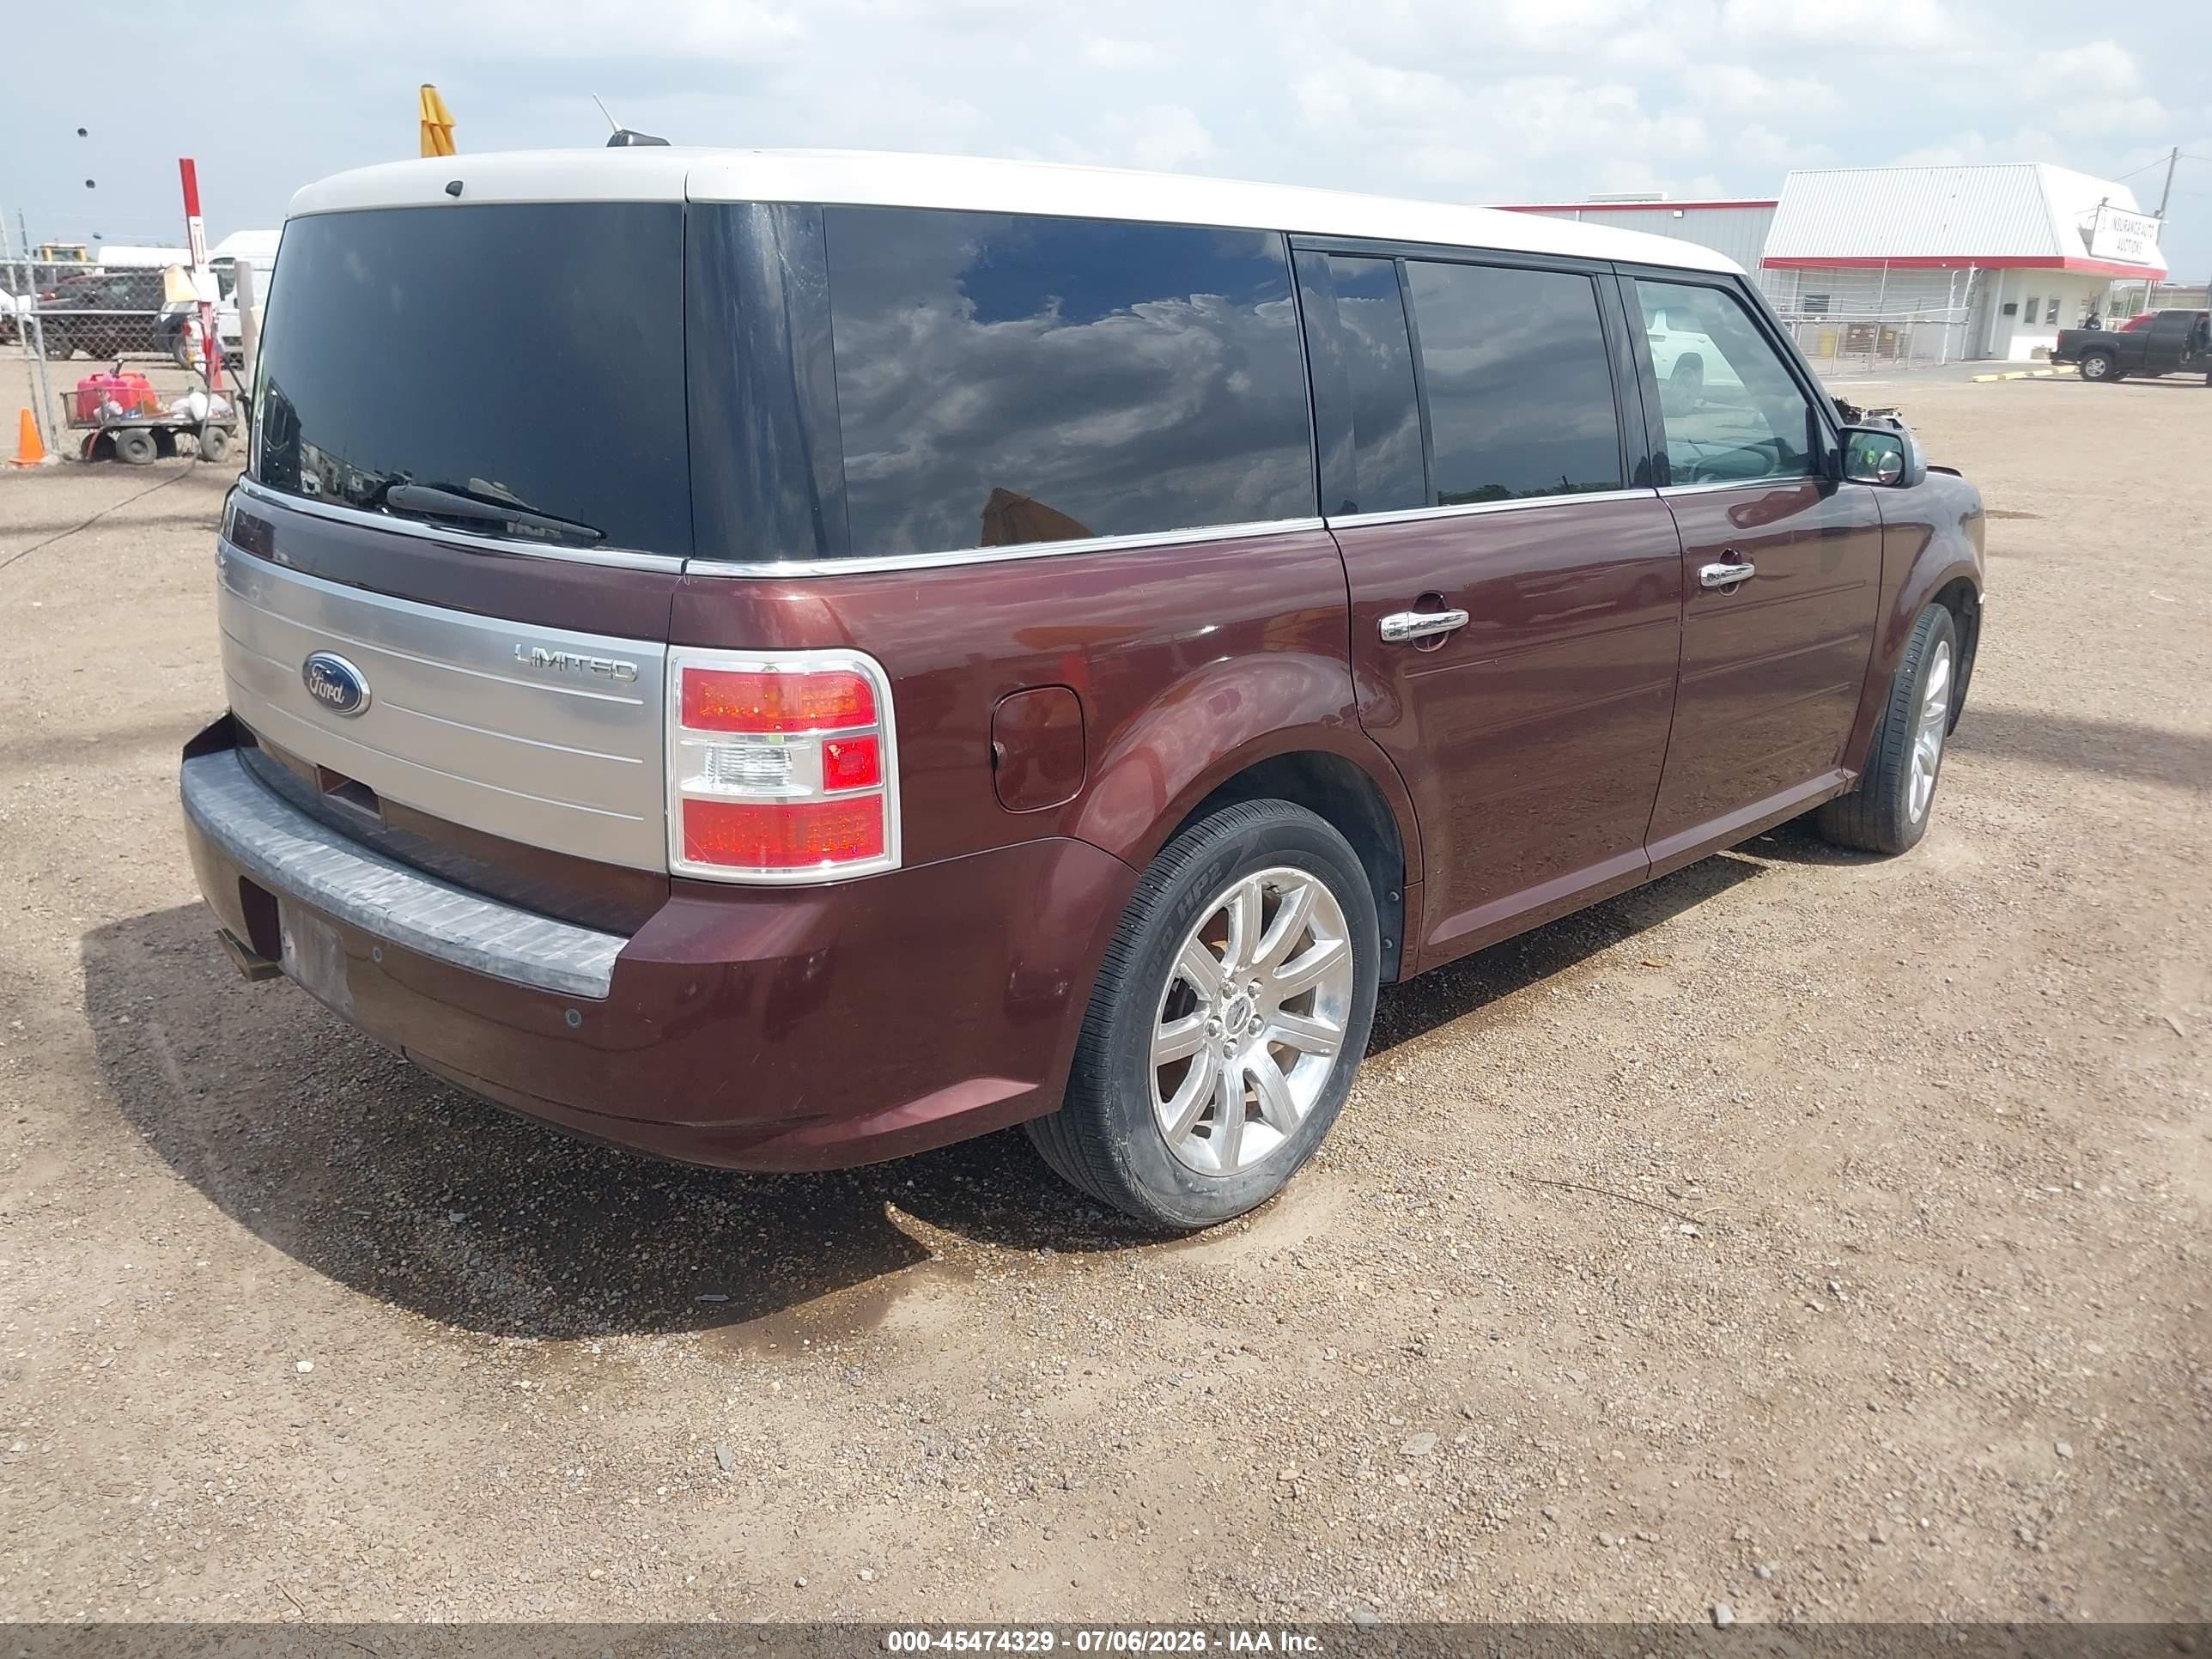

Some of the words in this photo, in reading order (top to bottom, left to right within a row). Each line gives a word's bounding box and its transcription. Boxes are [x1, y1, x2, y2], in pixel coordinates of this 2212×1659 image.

[2112, 216, 2142, 235] INSURANCE
[514, 643, 639, 682] LIMITED
[309, 663, 345, 703] Ford
[1177, 862, 1222, 922] HP2
